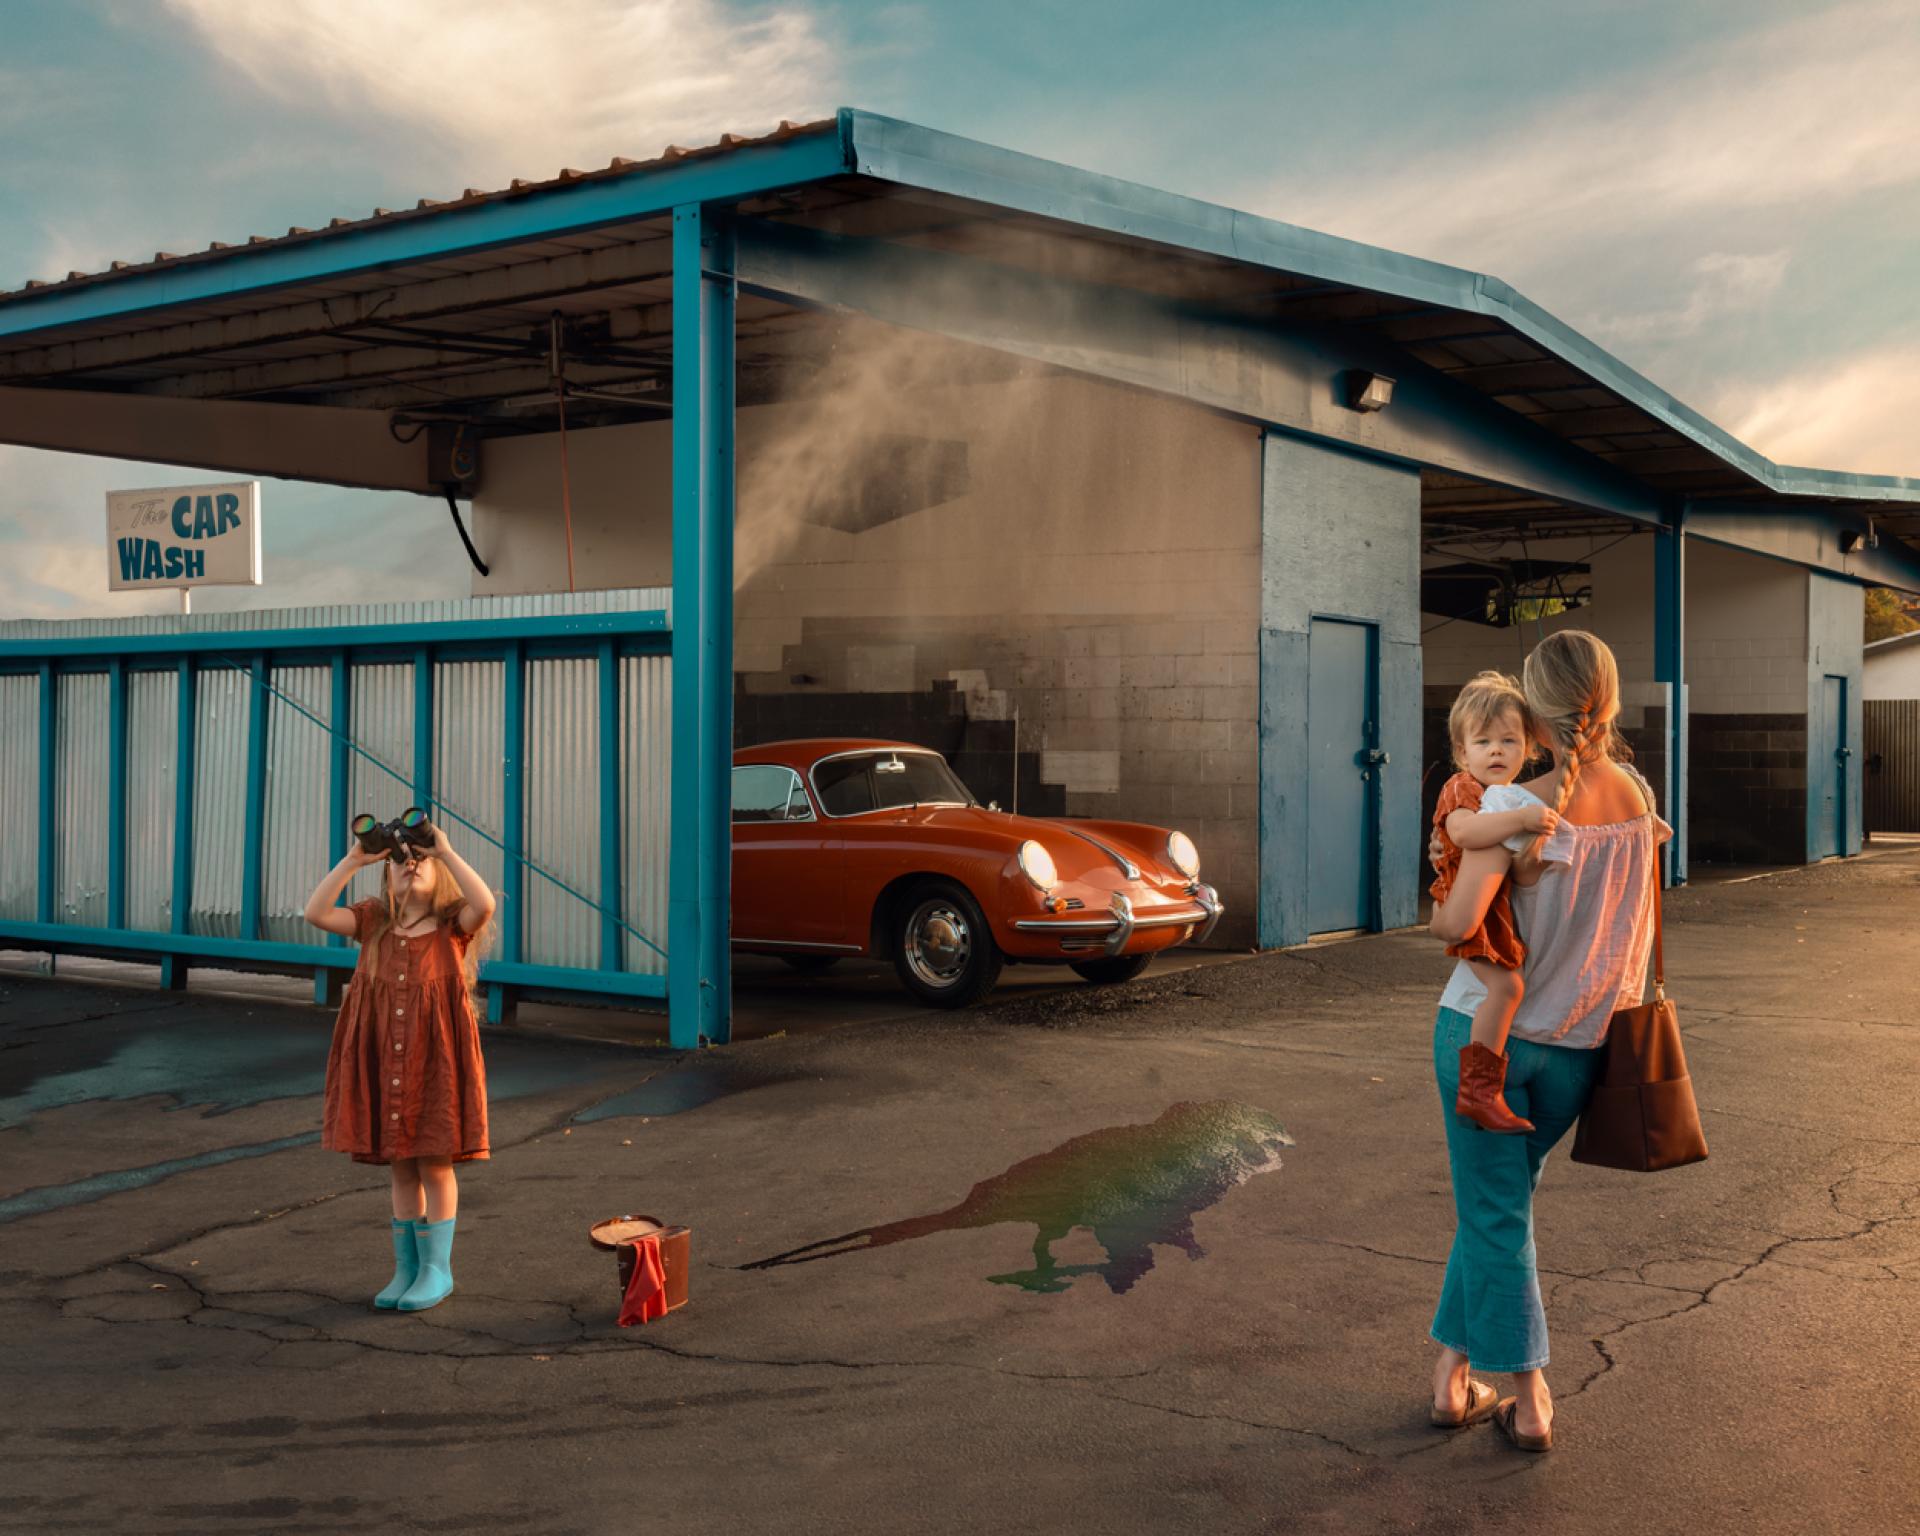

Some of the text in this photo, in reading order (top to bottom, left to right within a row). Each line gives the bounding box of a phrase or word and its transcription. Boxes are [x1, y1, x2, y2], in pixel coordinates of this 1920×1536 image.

[130, 493, 241, 539] The CAR
[117, 537, 205, 581] WASH
